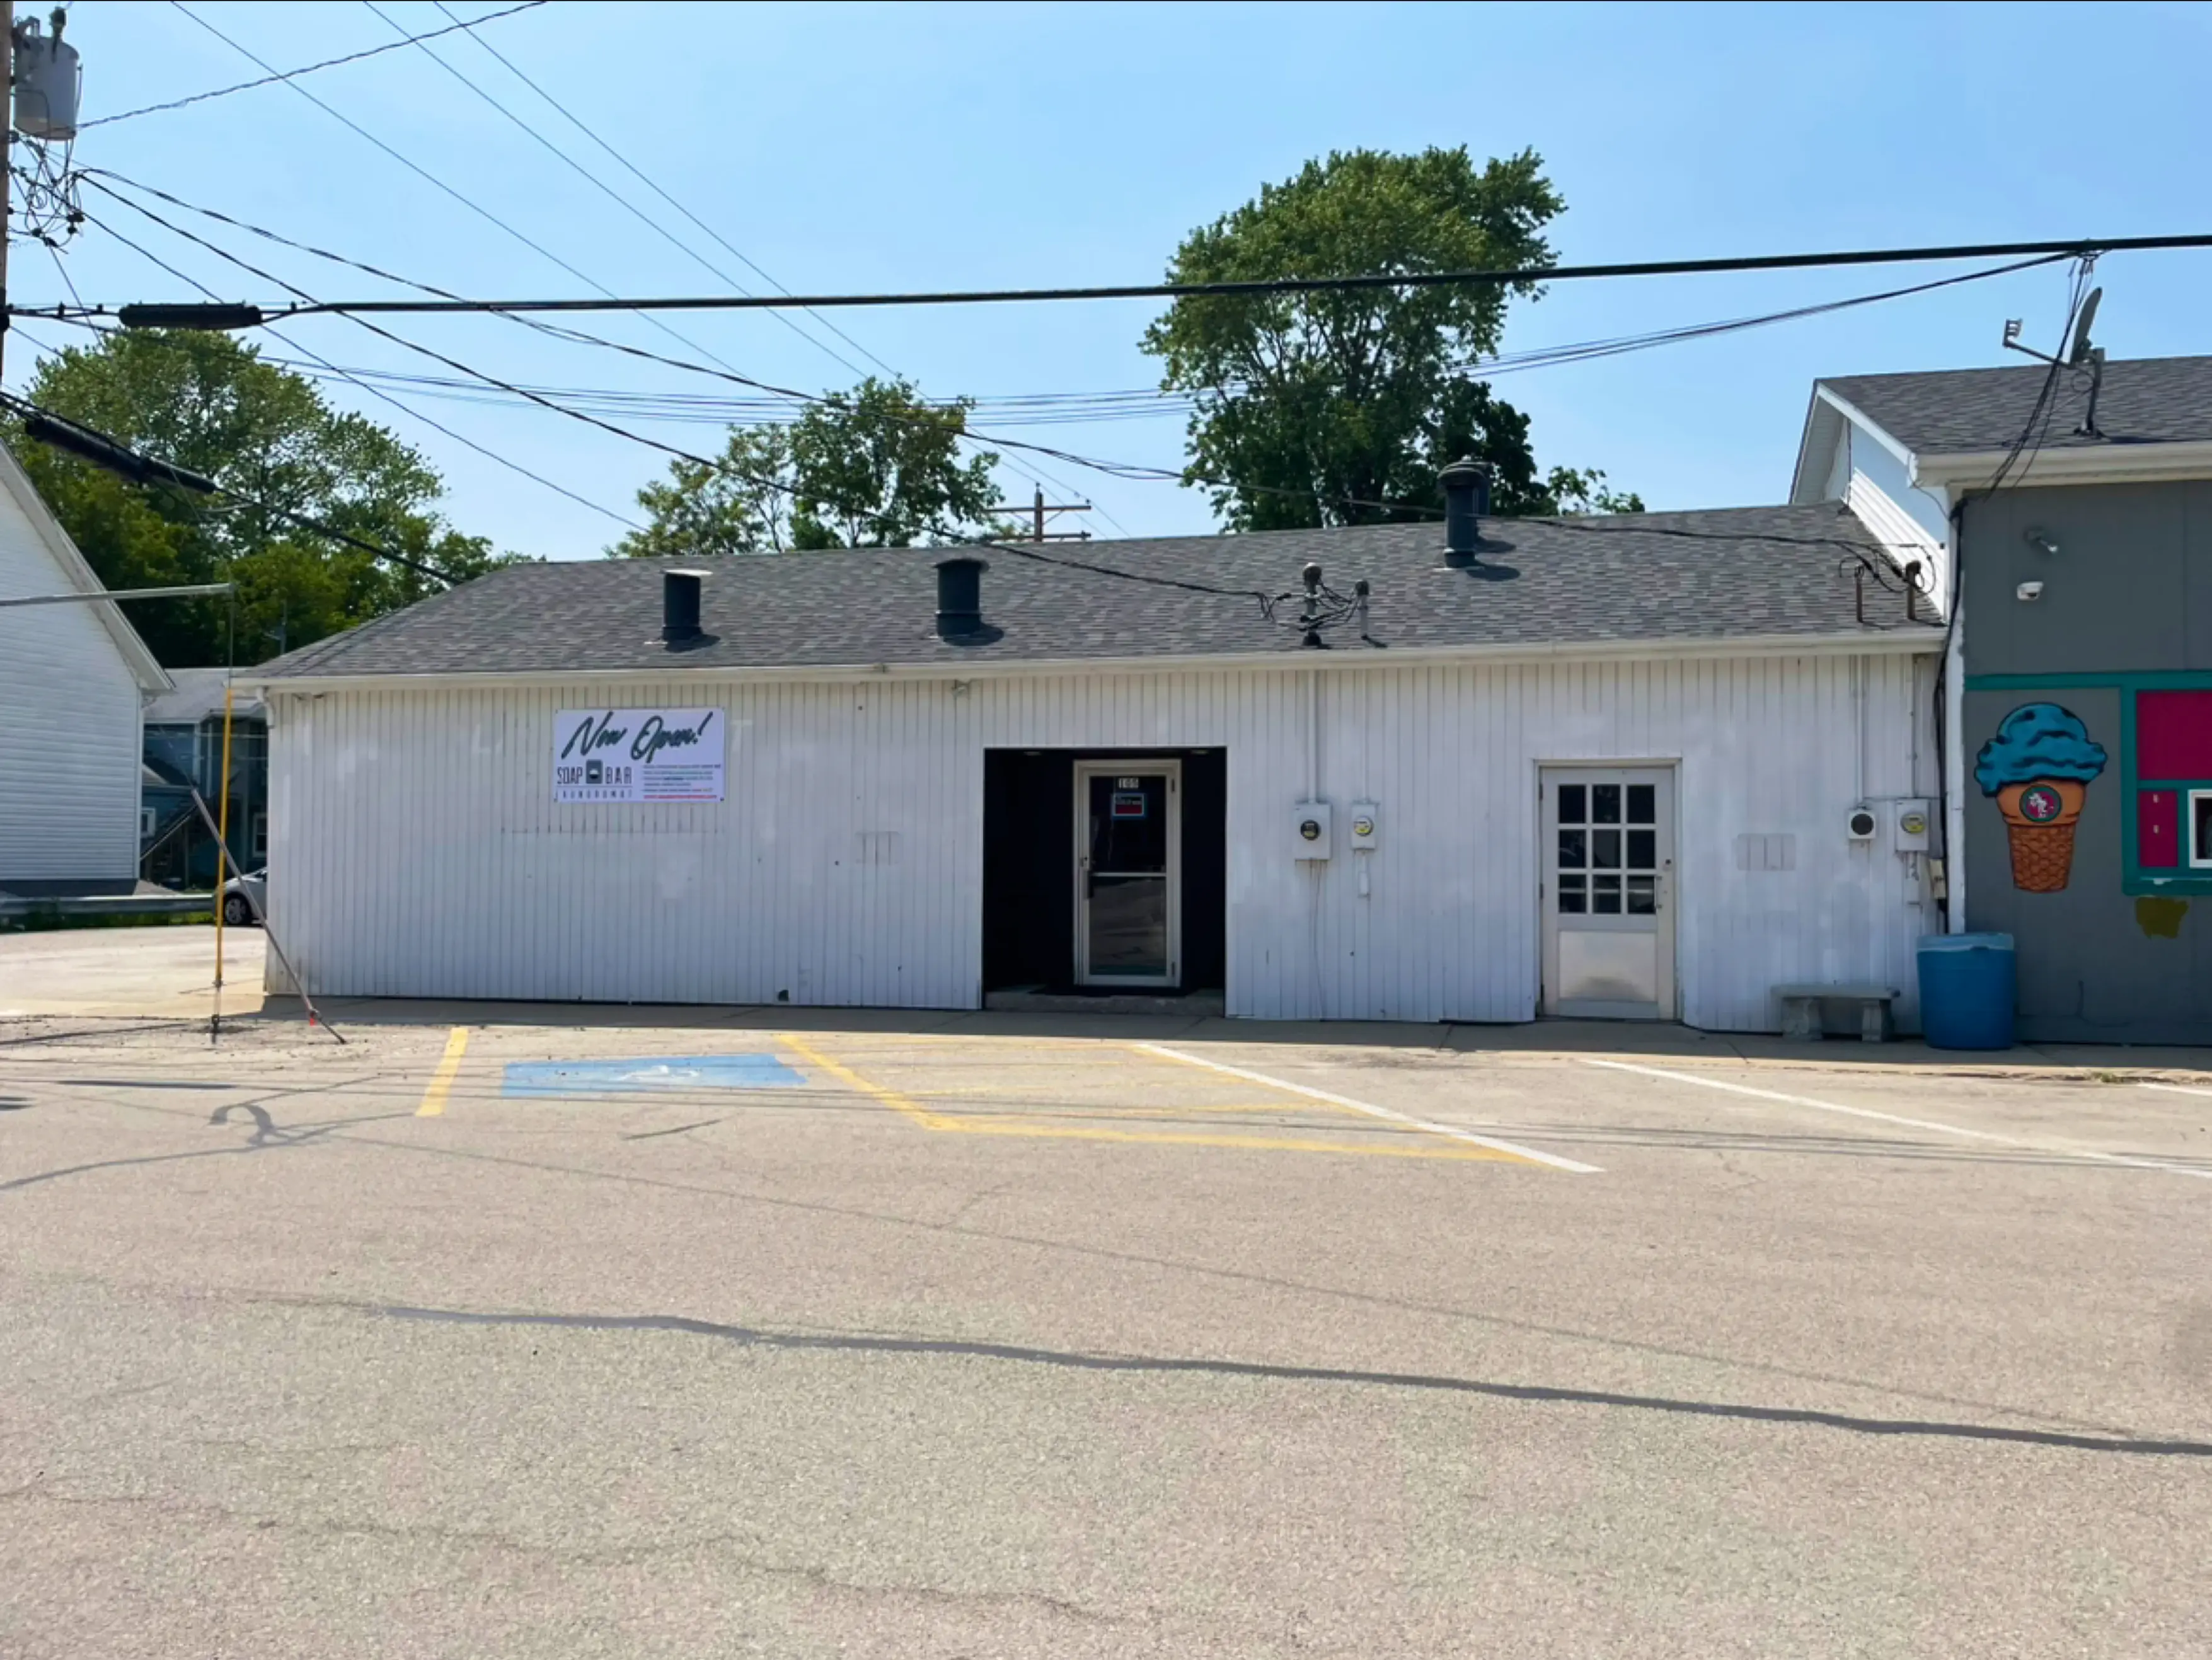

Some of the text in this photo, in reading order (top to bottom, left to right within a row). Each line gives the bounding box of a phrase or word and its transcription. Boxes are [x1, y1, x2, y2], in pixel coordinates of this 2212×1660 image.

[561, 711, 713, 764] Now Open!
[557, 766, 632, 785] SOAP BAR
